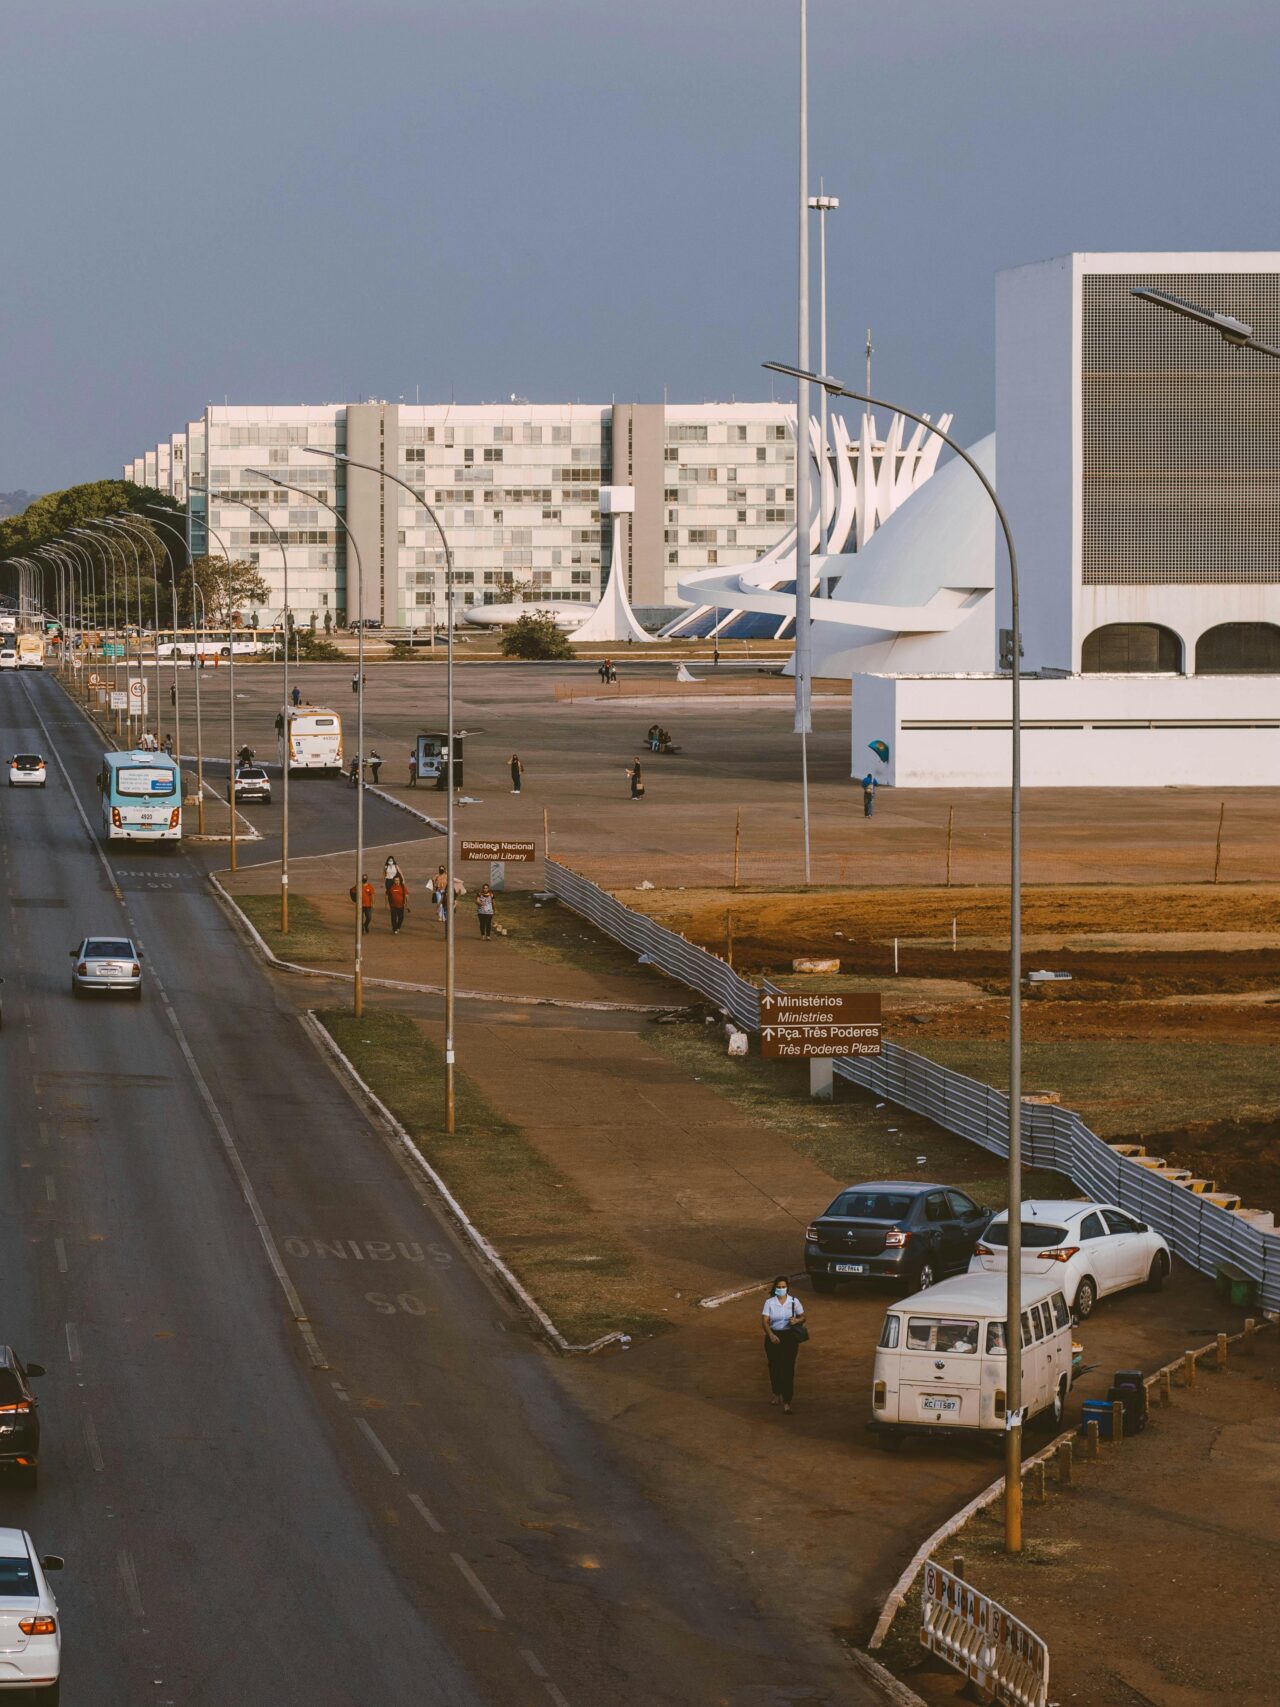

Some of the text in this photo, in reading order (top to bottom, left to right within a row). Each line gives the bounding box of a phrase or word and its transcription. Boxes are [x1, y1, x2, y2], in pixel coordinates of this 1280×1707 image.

[501, 842, 534, 850] Nacional
[469, 852, 527, 861] National Library
[777, 995, 843, 1007] Ministérios
[777, 1012, 833, 1022] Ministries
[777, 1027, 879, 1040] Pça. Três Poderes
[778, 1043, 880, 1055] Três Poderes Plaza
